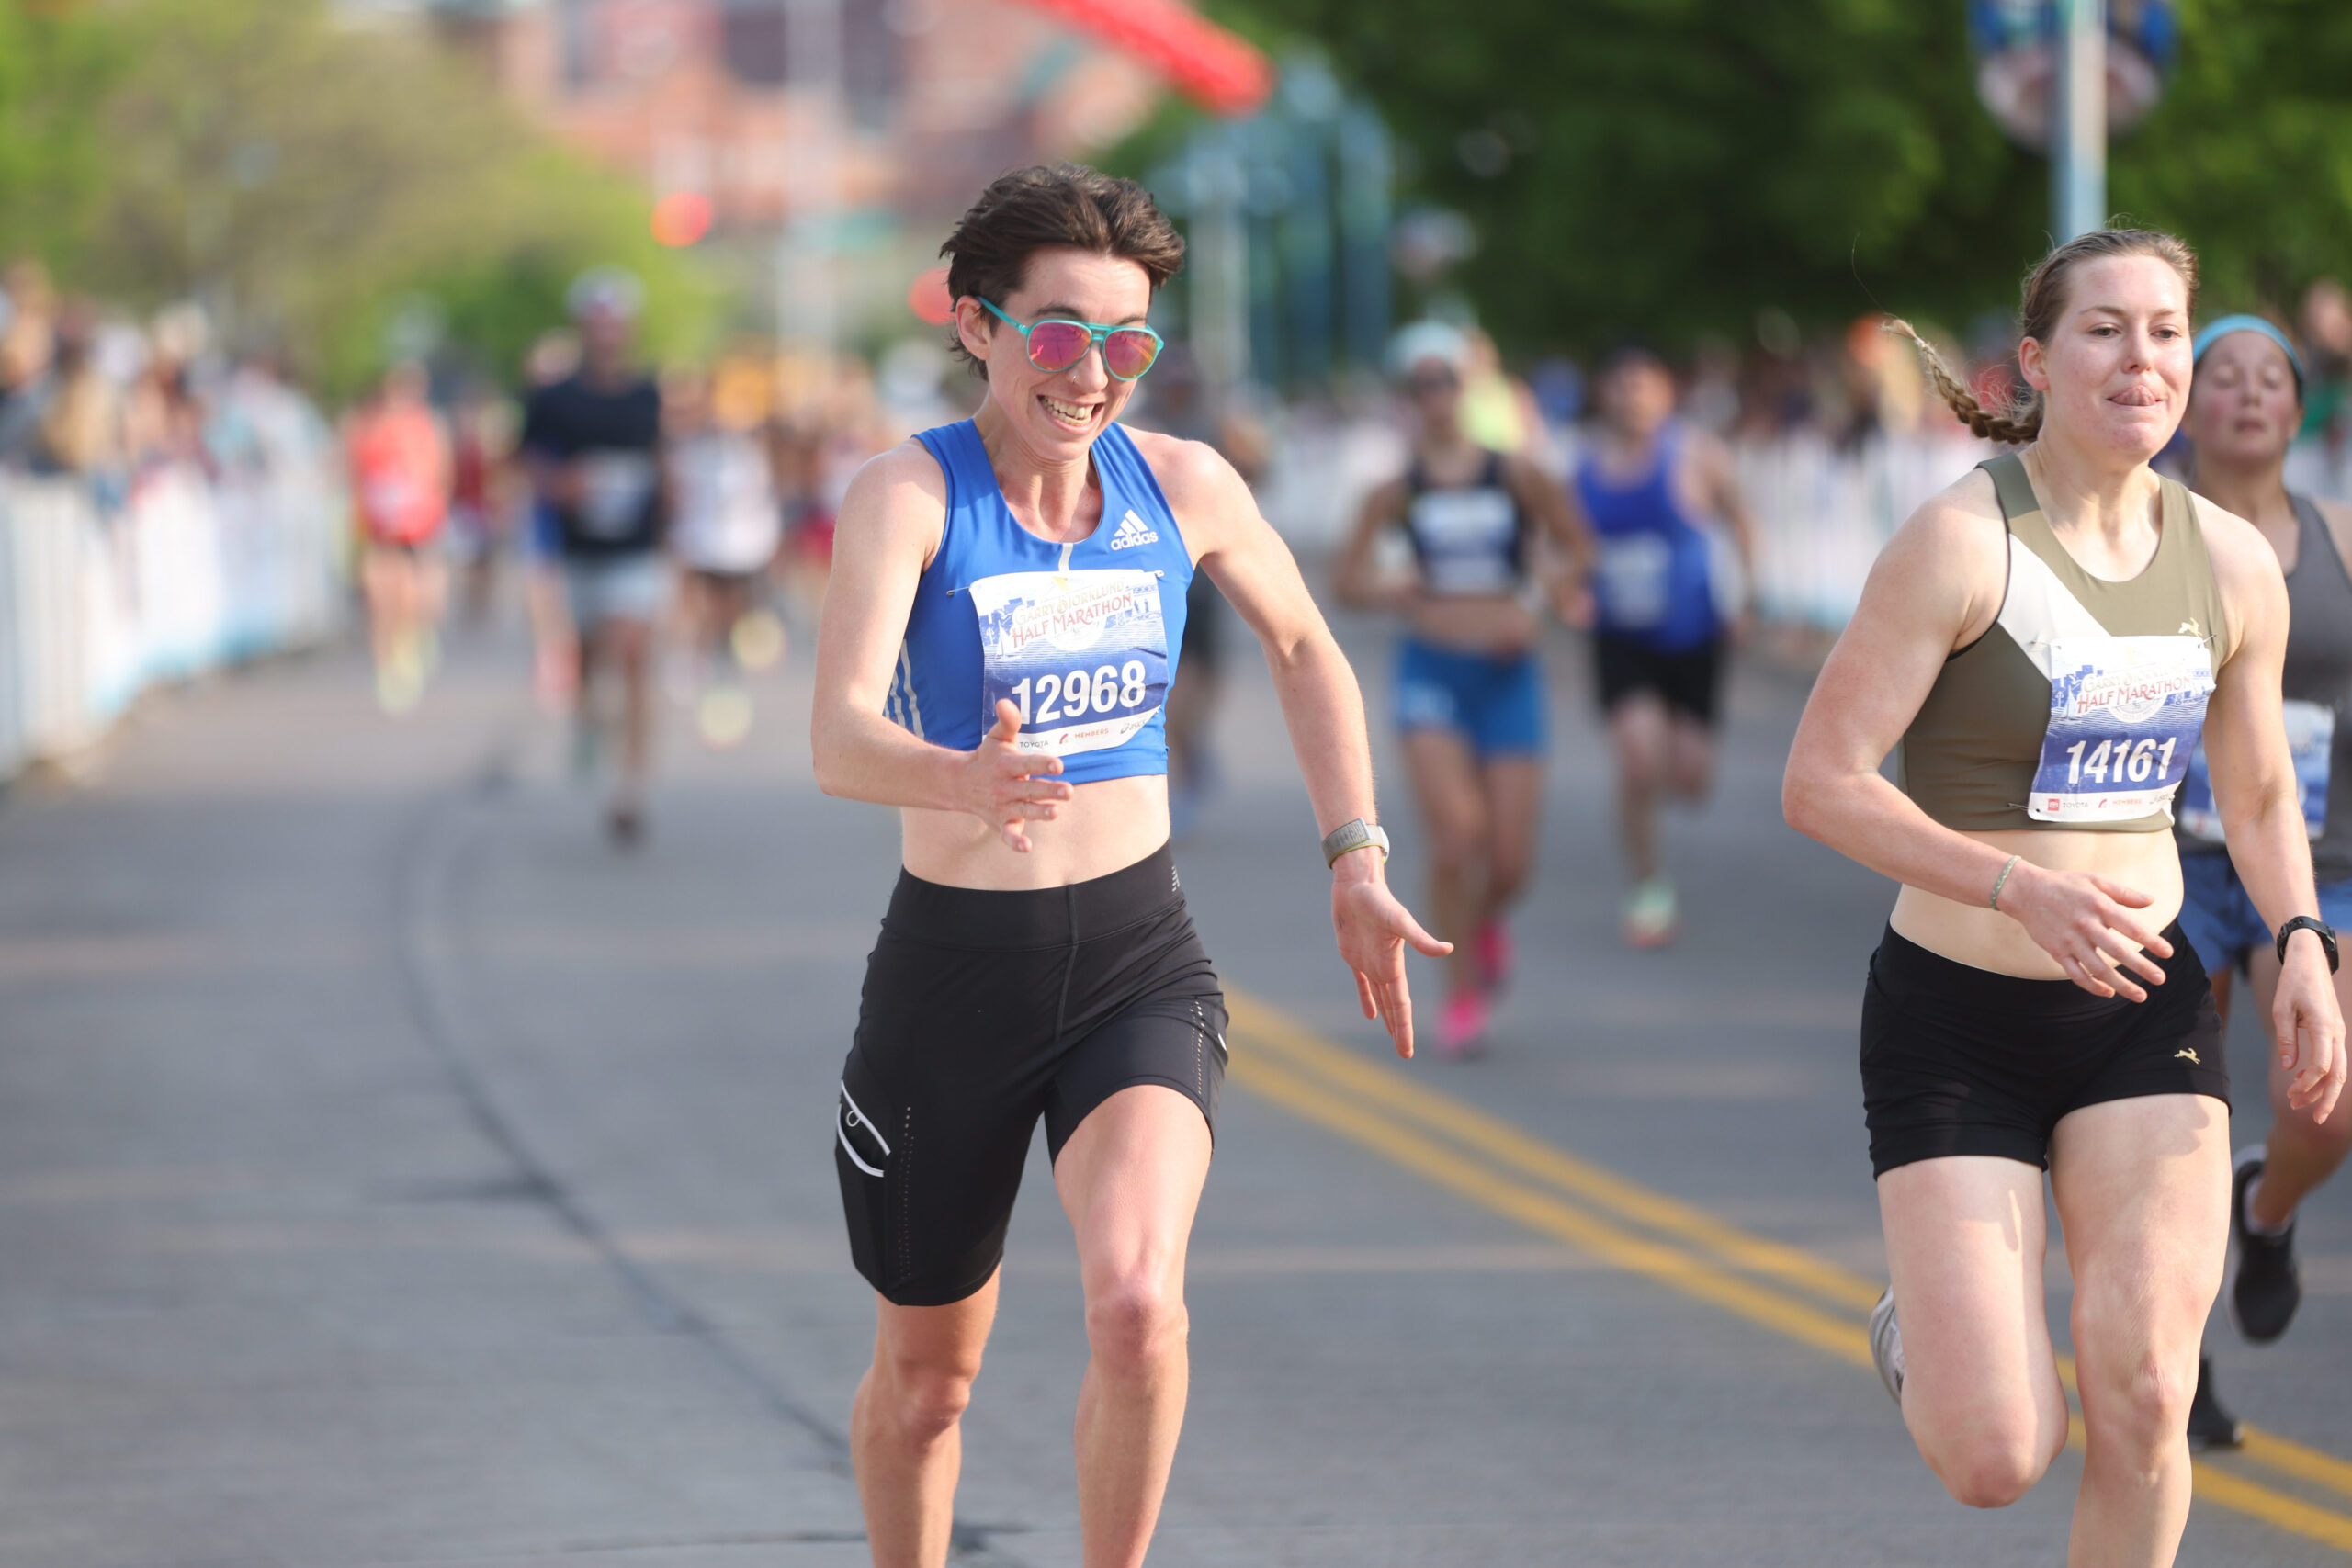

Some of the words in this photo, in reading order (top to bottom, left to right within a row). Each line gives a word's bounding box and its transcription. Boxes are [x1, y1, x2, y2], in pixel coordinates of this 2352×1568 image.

[1111, 530, 1159, 550] adidas
[1012, 619, 1049, 649] HALF
[1053, 592, 1133, 634] MARATHON
[1013, 602, 1056, 626] GARRY
[1012, 660, 1147, 725] 12968
[2077, 690, 2114, 714] HALF
[2116, 677, 2192, 705] MARATHON
[1020, 739, 1049, 749] TOYOTA
[1074, 728, 1110, 739] MEMBERS
[2066, 737, 2177, 784] 14161
[2063, 801, 2089, 809] TOYOTA
